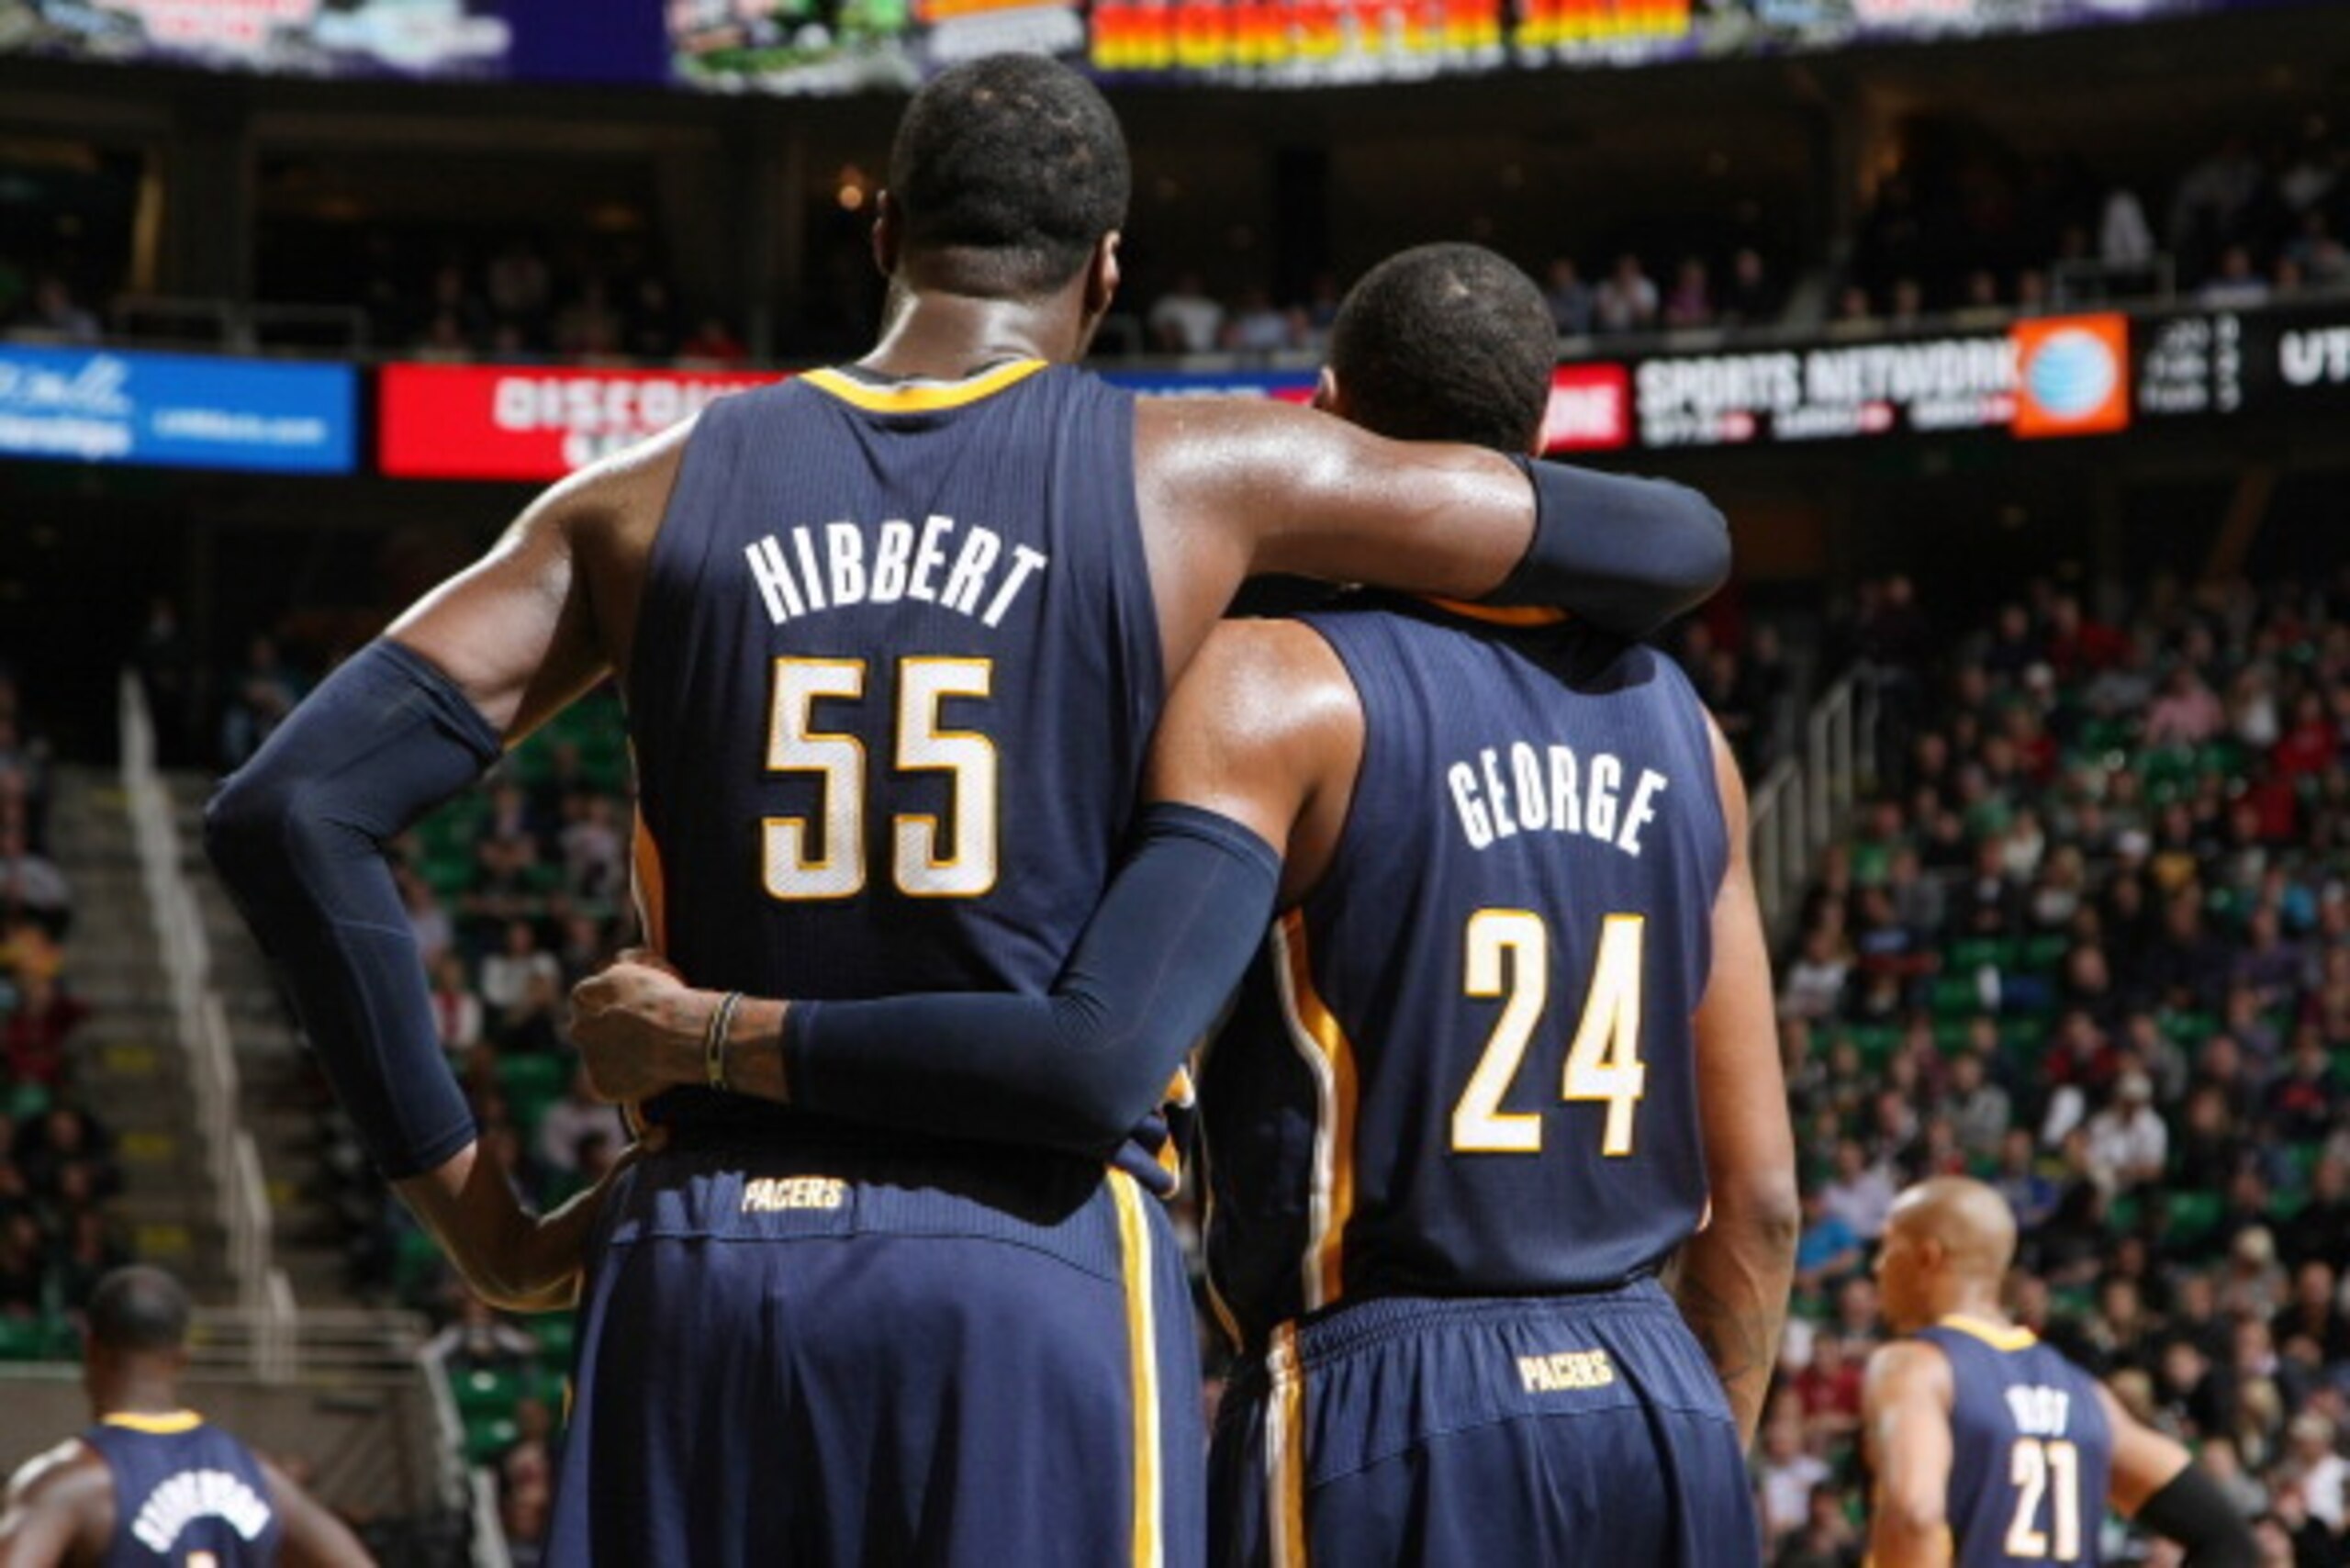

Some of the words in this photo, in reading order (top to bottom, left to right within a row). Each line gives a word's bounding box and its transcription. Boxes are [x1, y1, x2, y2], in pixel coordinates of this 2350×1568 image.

[1637, 352, 1799, 411] SPORTS
[1806, 337, 2017, 404] NETWORK
[744, 514, 1048, 628] HIBBERT
[762, 655, 998, 899] 55
[1448, 741, 1668, 857] GEORGE
[1450, 908, 1646, 1156] 24
[742, 1176, 843, 1213] PACERS
[1516, 1349, 1614, 1394] PACERS
[2004, 1437, 2081, 1561] 21
